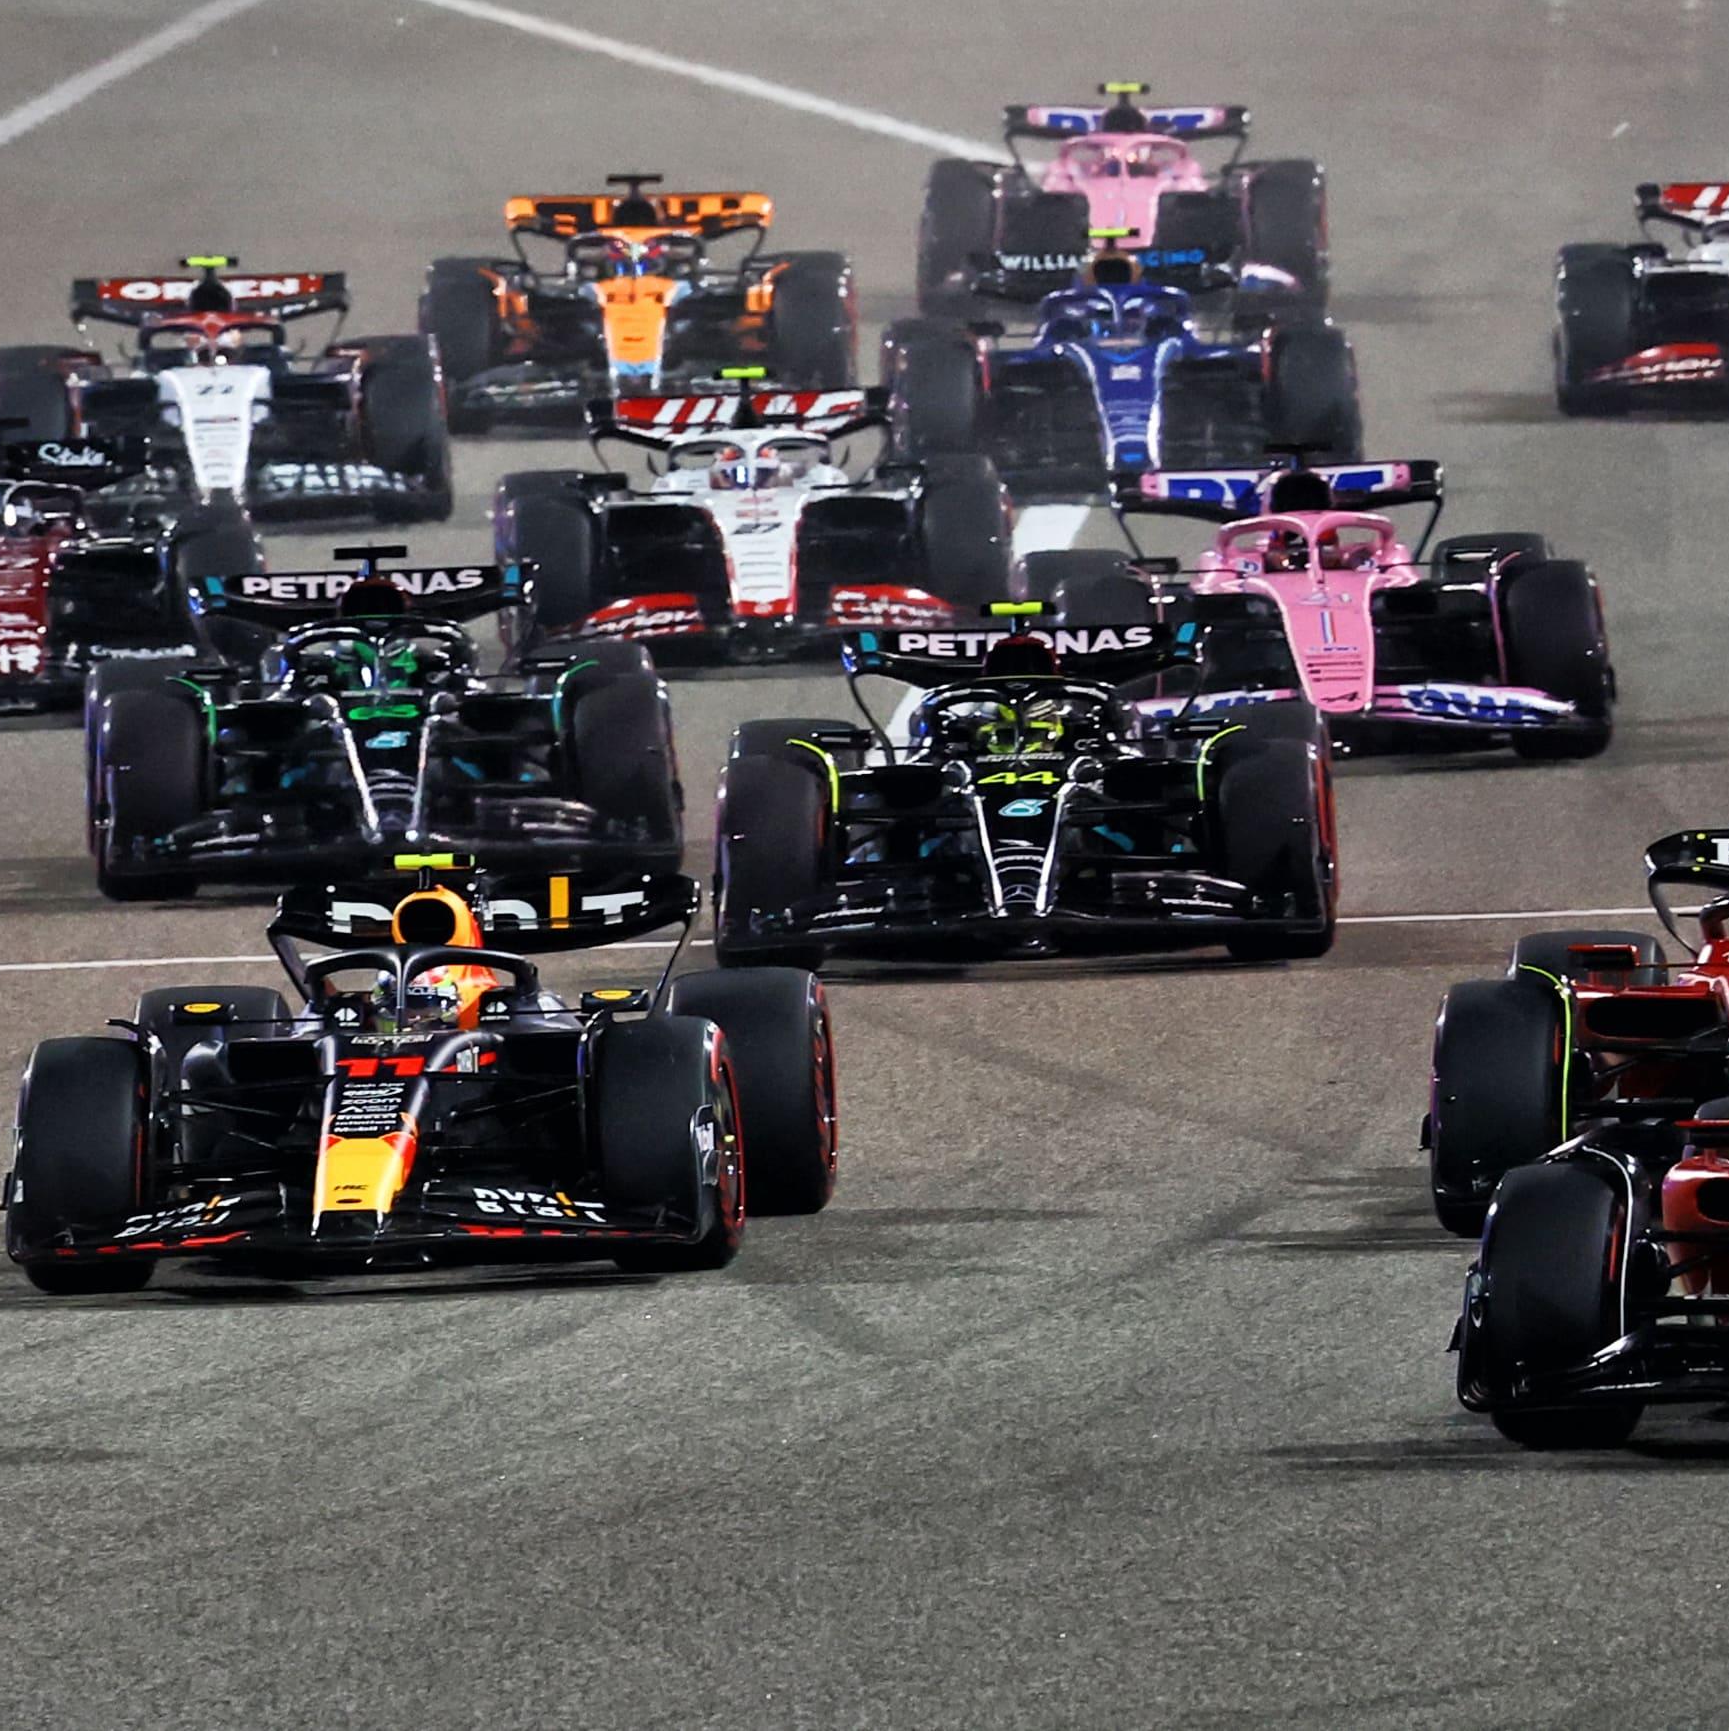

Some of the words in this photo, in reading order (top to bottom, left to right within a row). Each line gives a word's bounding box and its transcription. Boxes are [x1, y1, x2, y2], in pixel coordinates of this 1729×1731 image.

[119, 279, 300, 301] OREN
[39, 442, 105, 466] Stake
[976, 770, 1061, 786] 44
[335, 1056, 425, 1078] 11
